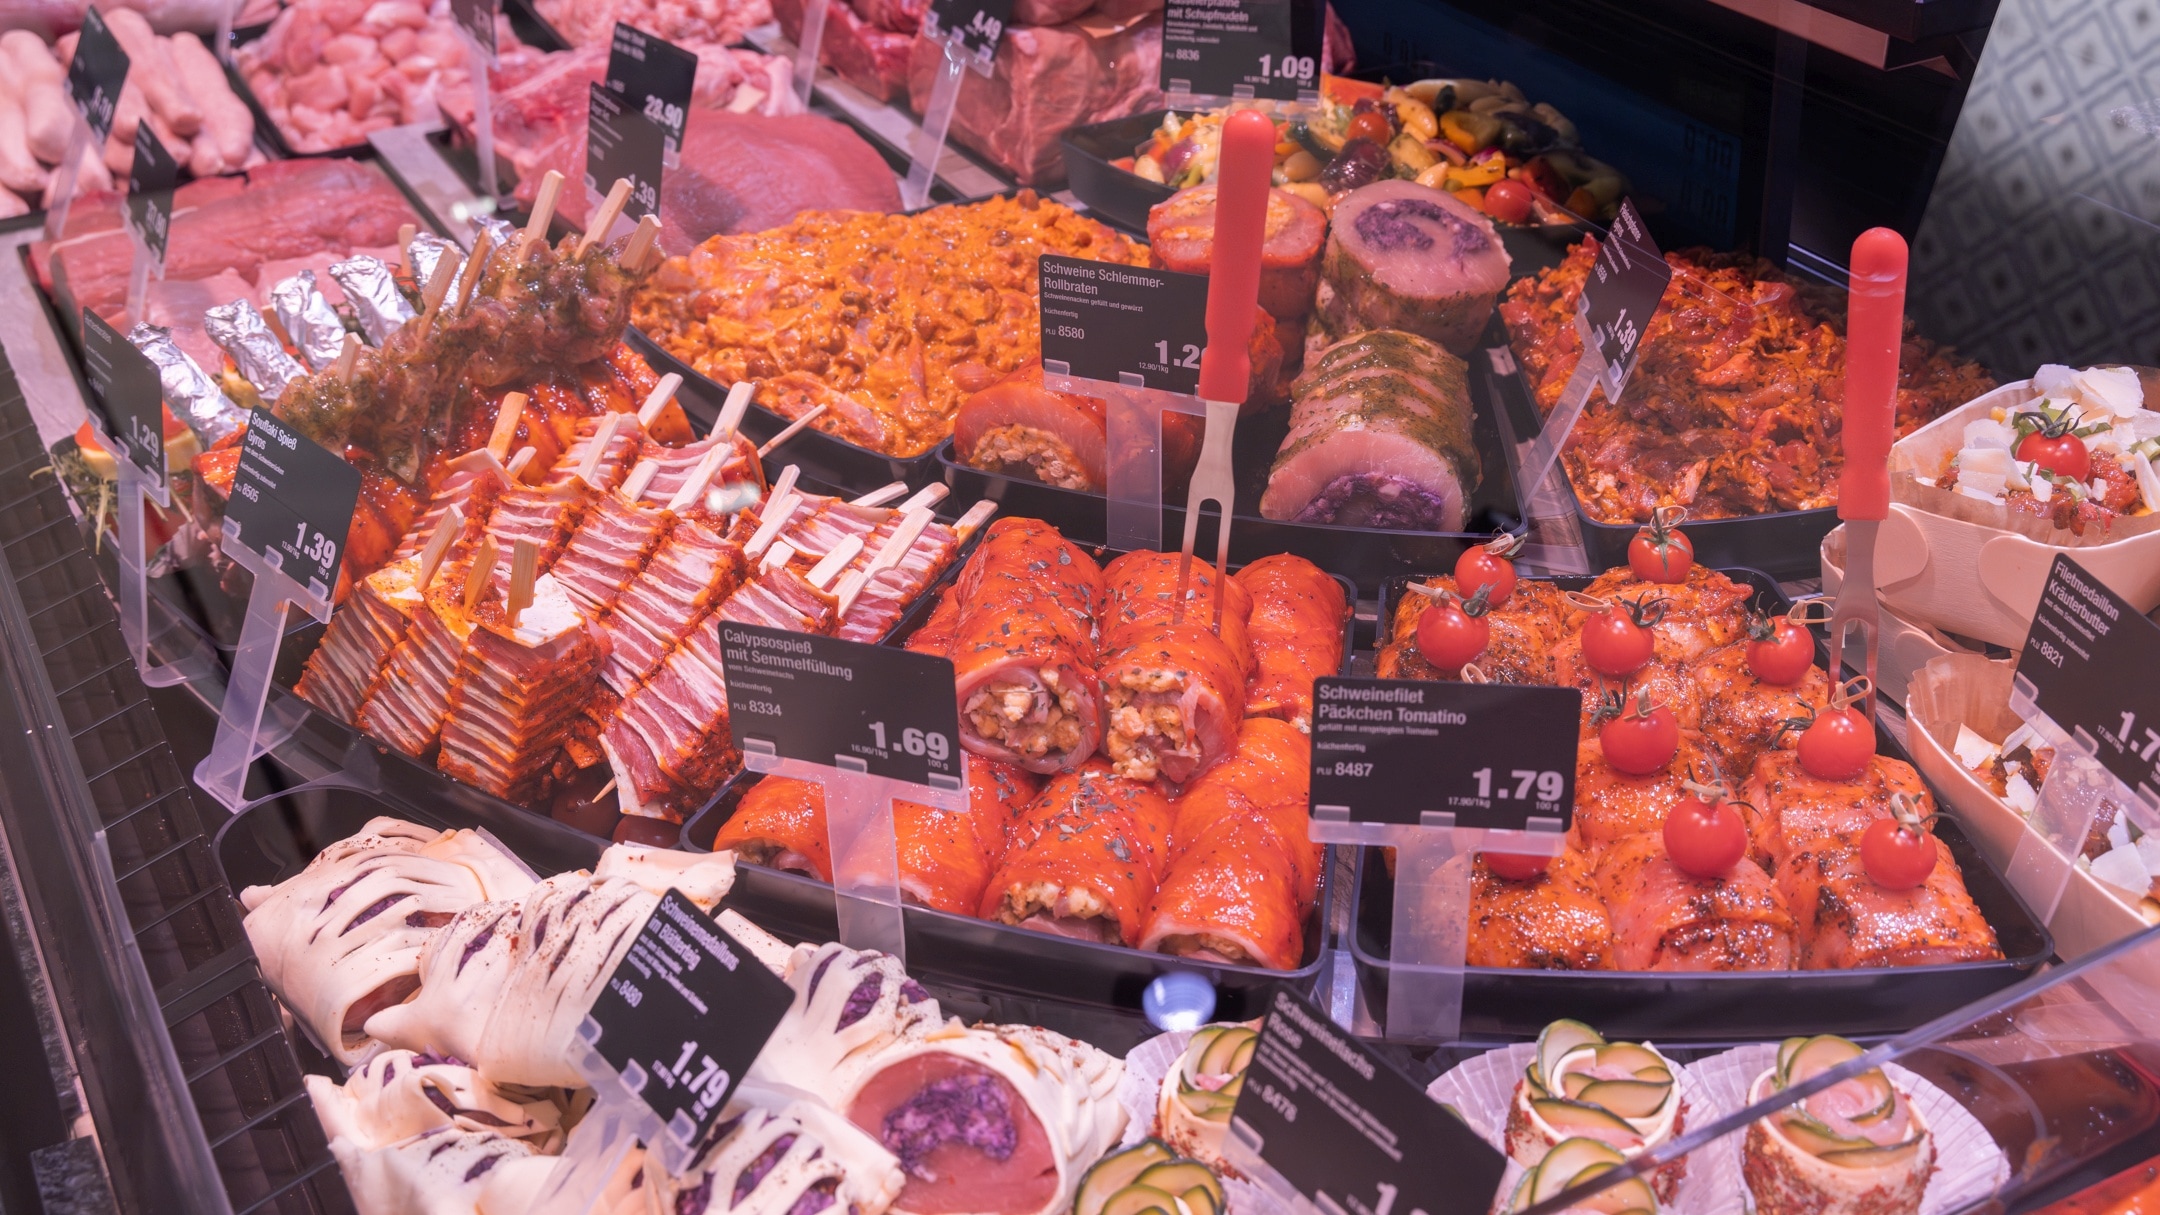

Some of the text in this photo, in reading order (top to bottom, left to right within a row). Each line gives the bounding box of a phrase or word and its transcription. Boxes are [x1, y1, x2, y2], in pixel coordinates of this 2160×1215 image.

[1259, 54, 1314, 79] 1.09
[644, 95, 683, 129] 28.90
[1043, 262, 1164, 288] Schweine Schlemmer-
[1044, 277, 1098, 295] Rollbraten
[1044, 292, 1089, 304] Schweinenacken
[1090, 298, 1108, 307] gefüllt
[1121, 304, 1143, 312] gewürzt
[1044, 308, 1078, 319] küchenfertig
[1058, 326, 1084, 339] 8580
[1614, 308, 1637, 353] 1.39
[1155, 340, 1208, 369] 1.2
[1139, 362, 1168, 374] 12.90/1kg
[131, 415, 159, 458] 1.29
[248, 430, 266, 450] Gyros
[278, 429, 297, 450] Spieß
[242, 483, 259, 502] 8505
[296, 522, 336, 569] 1.39
[2054, 561, 2119, 621] Filetmedaillon
[2049, 579, 2110, 636] Kräuterbutter
[724, 629, 812, 654] Calypsospieß
[2030, 637, 2064, 668] PLU 8821
[727, 649, 852, 681] mit Semmelfüllung
[730, 680, 772, 694] küchenfertig
[1319, 684, 1424, 704] Schweinefilet
[734, 700, 782, 717] PLU 8334
[1319, 705, 1467, 725] Päckchen Tomatino
[869, 721, 949, 760] 1.69
[1344, 724, 1357, 733] mit
[1317, 741, 1366, 752] küchenfertig
[2118, 711, 2160, 774] 1.7
[851, 744, 948, 771] 16.90/1kg 100 g
[1317, 762, 1373, 777] PLU 8487
[1473, 768, 1564, 801] 1.79
[1448, 797, 1559, 812] 17.90/1kg 100 g
[648, 914, 701, 971] im Blätterteig
[661, 895, 739, 972] Schweinemedaillons
[672, 1040, 730, 1109] 1.79
